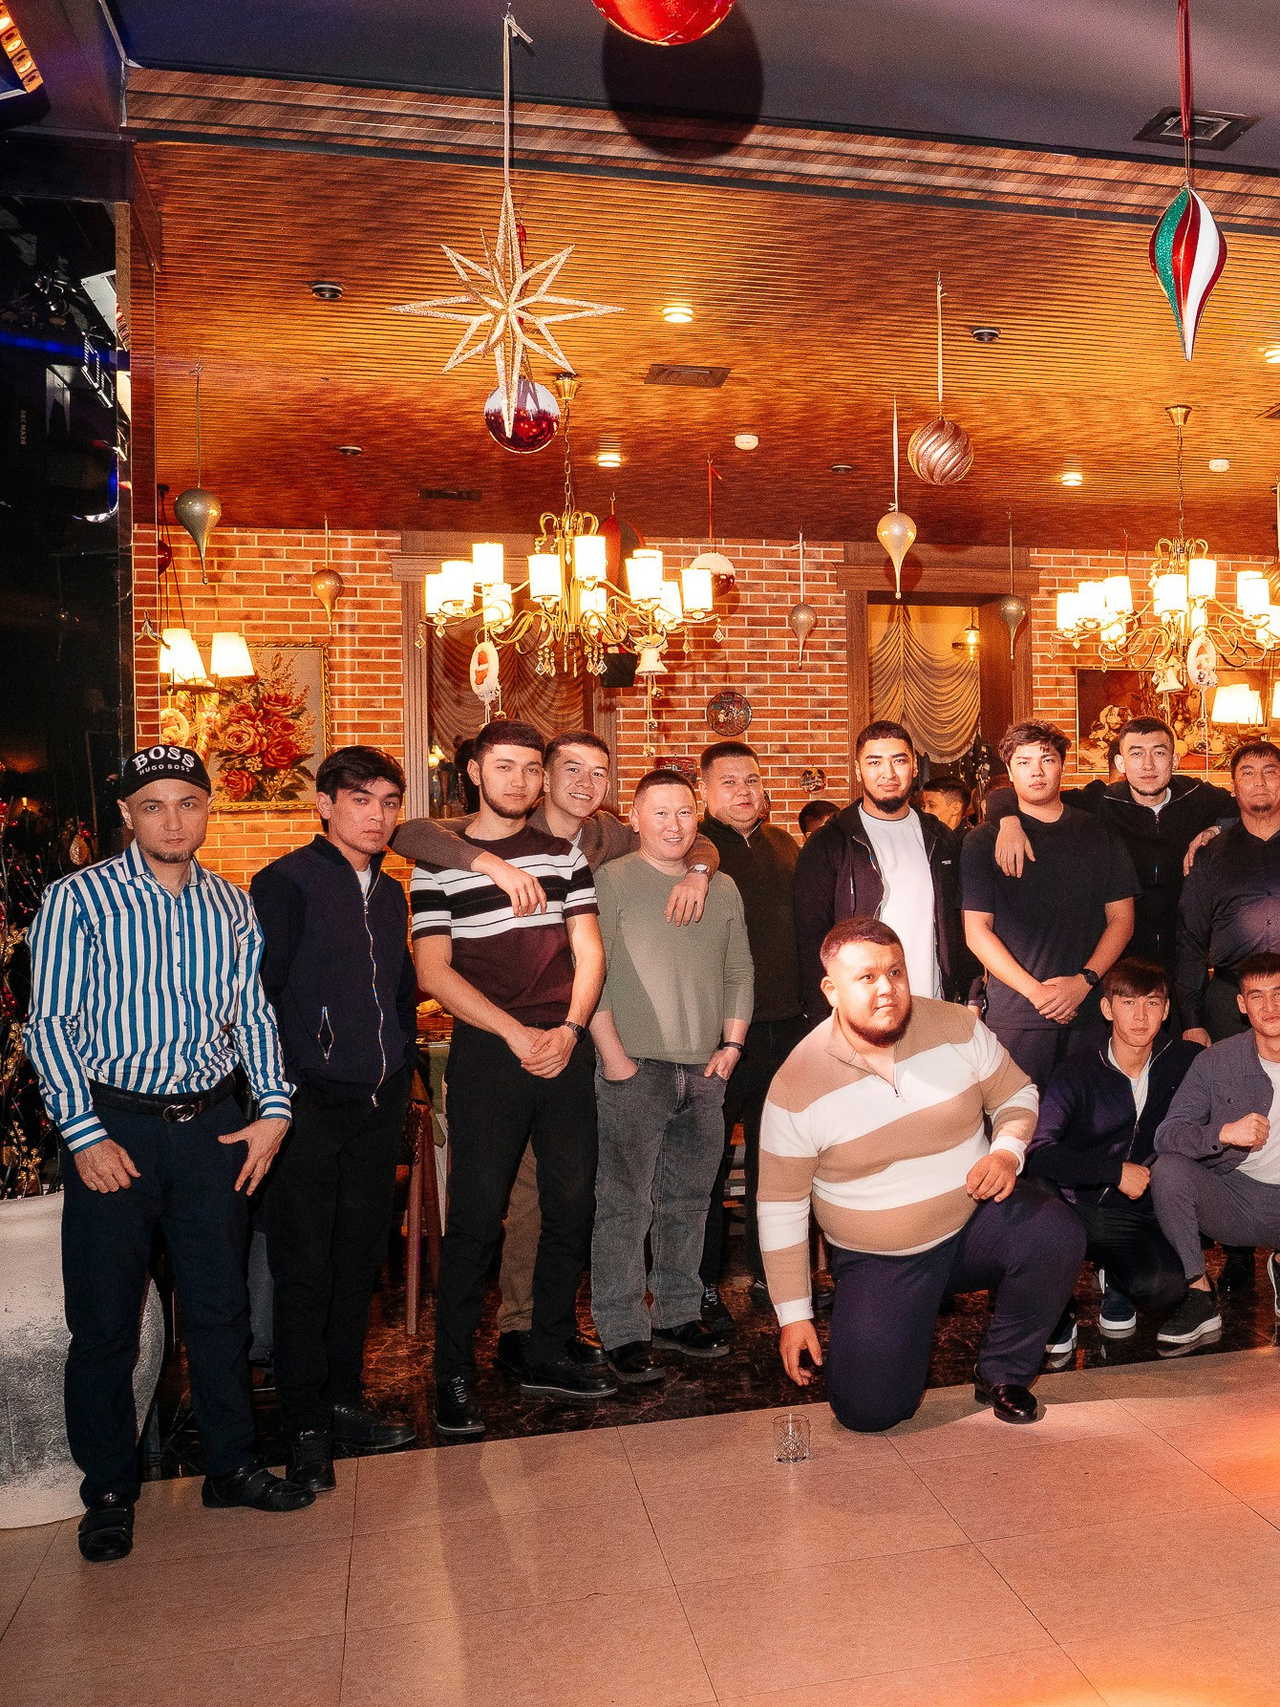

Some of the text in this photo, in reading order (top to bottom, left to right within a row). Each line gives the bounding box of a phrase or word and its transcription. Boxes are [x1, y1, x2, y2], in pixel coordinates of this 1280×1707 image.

[132, 746, 195, 771] BOSS
[139, 763, 191, 775] HUGO BOSS
